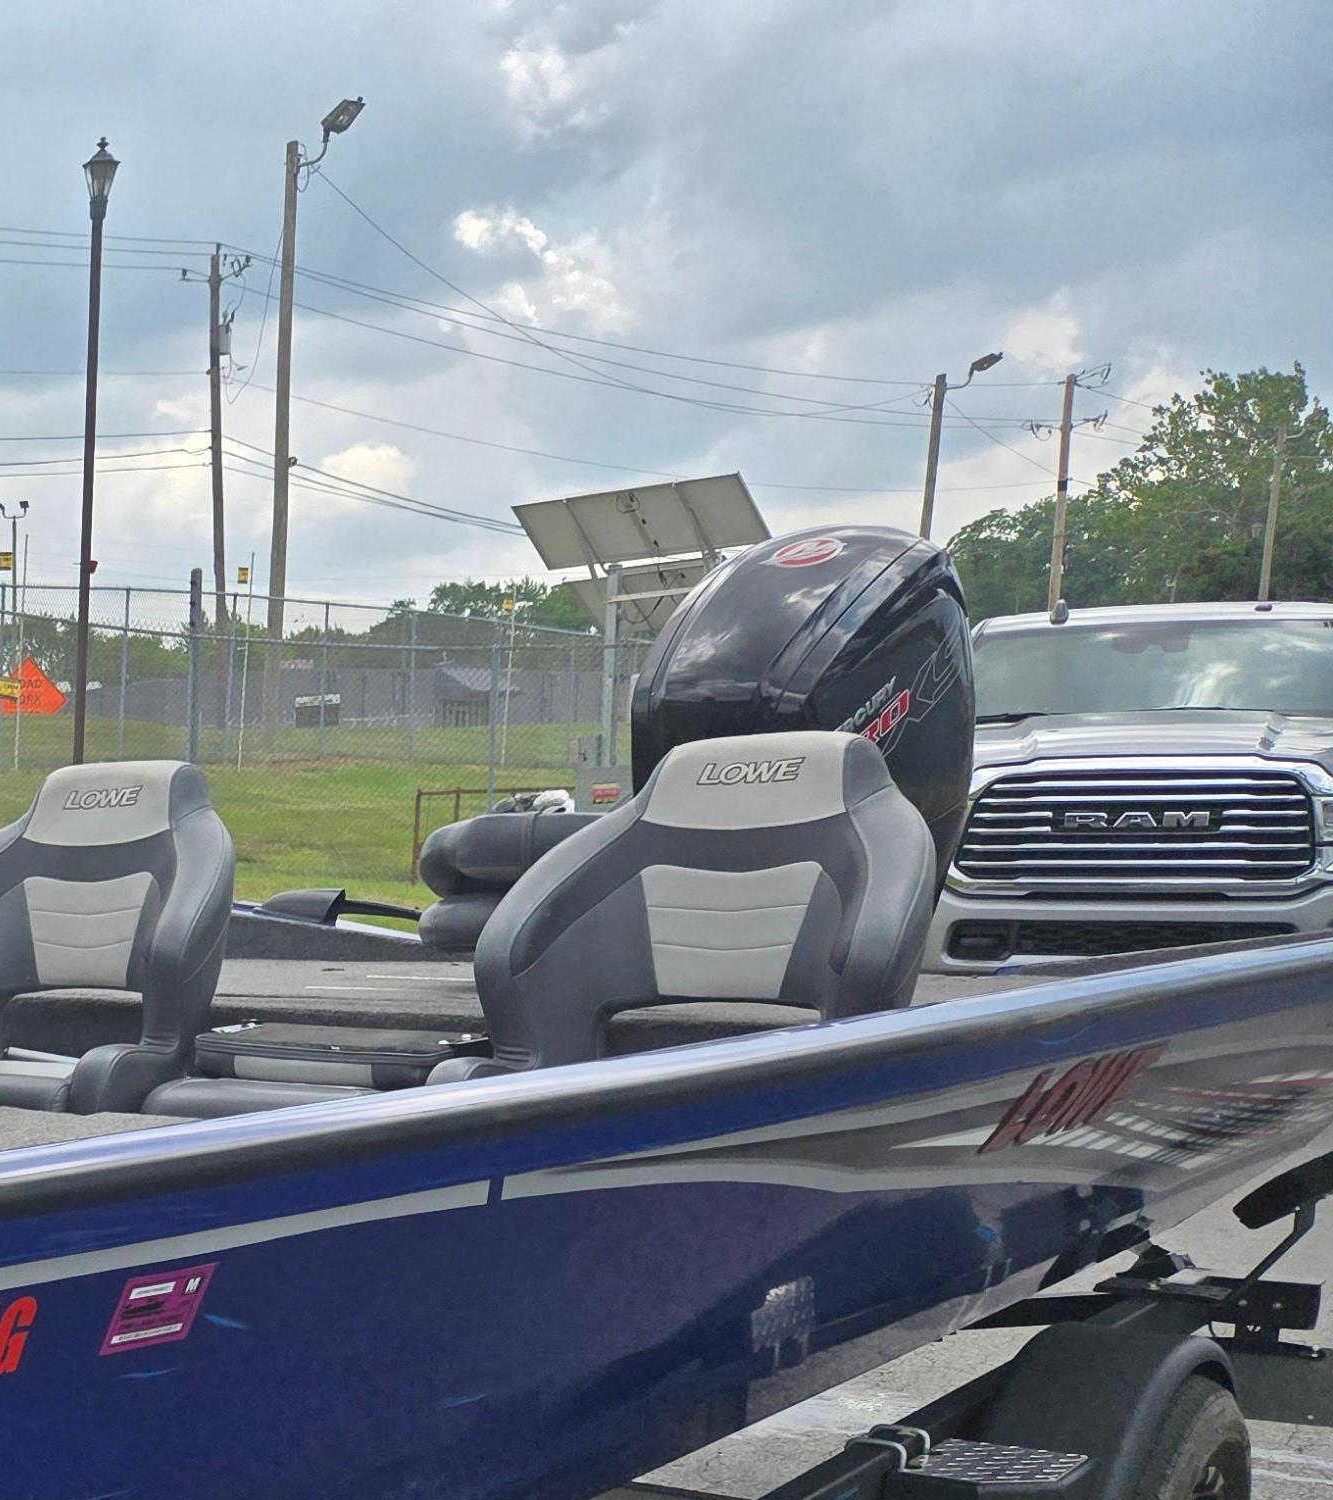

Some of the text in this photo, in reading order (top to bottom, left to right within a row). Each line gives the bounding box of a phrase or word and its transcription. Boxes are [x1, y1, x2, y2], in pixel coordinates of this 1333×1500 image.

[835, 675, 896, 732] RCURY
[696, 757, 806, 785] LOWE
[62, 785, 143, 810] LOWE
[1064, 811, 1210, 828] RAM
